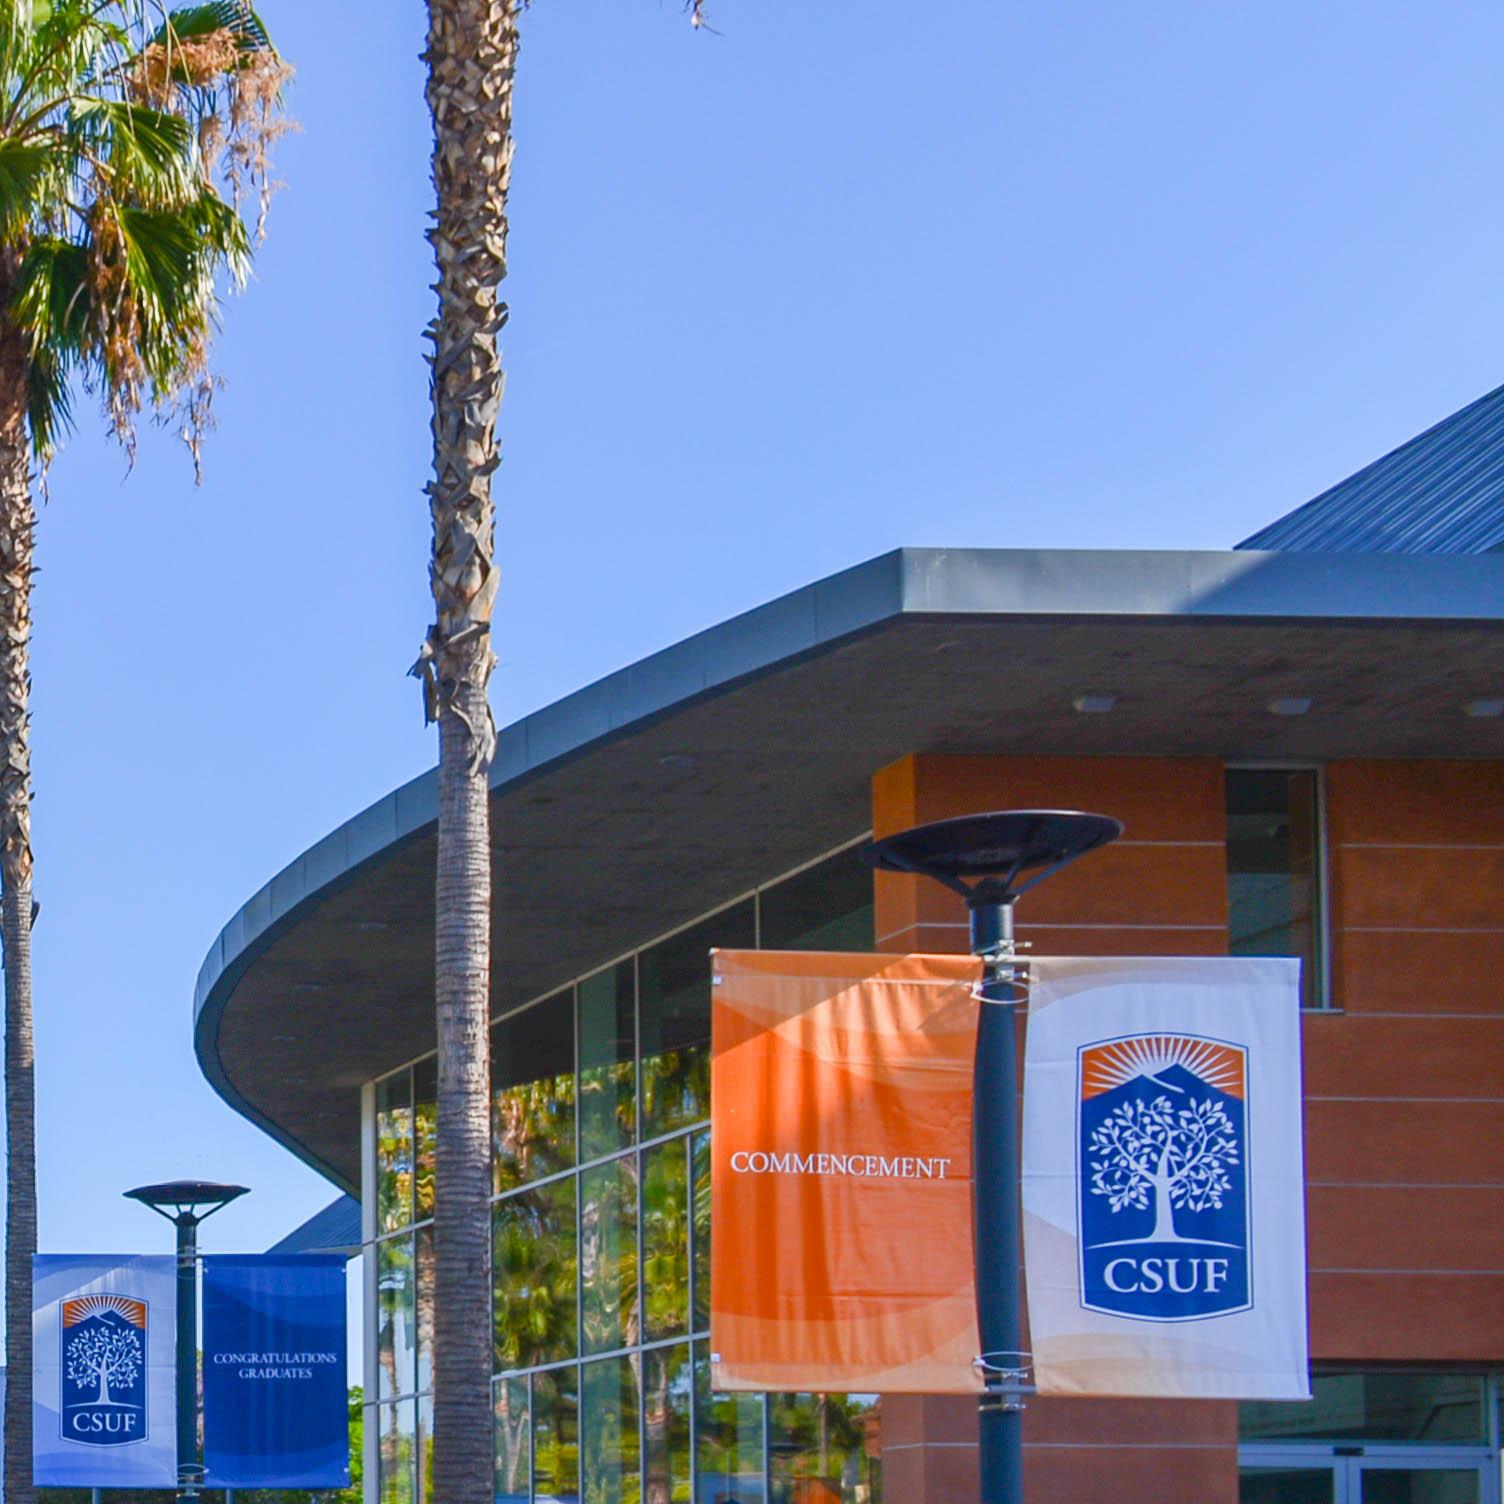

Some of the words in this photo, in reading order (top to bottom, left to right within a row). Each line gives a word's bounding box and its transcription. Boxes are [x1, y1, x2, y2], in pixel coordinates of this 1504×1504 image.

[730, 1151, 951, 1179] COMMENCEMENT
[1104, 1257, 1229, 1295] CSUF
[213, 1352, 338, 1365] CONGRATULATIONS
[238, 1367, 313, 1380] GRADUATES
[72, 1412, 137, 1433] CSUF
